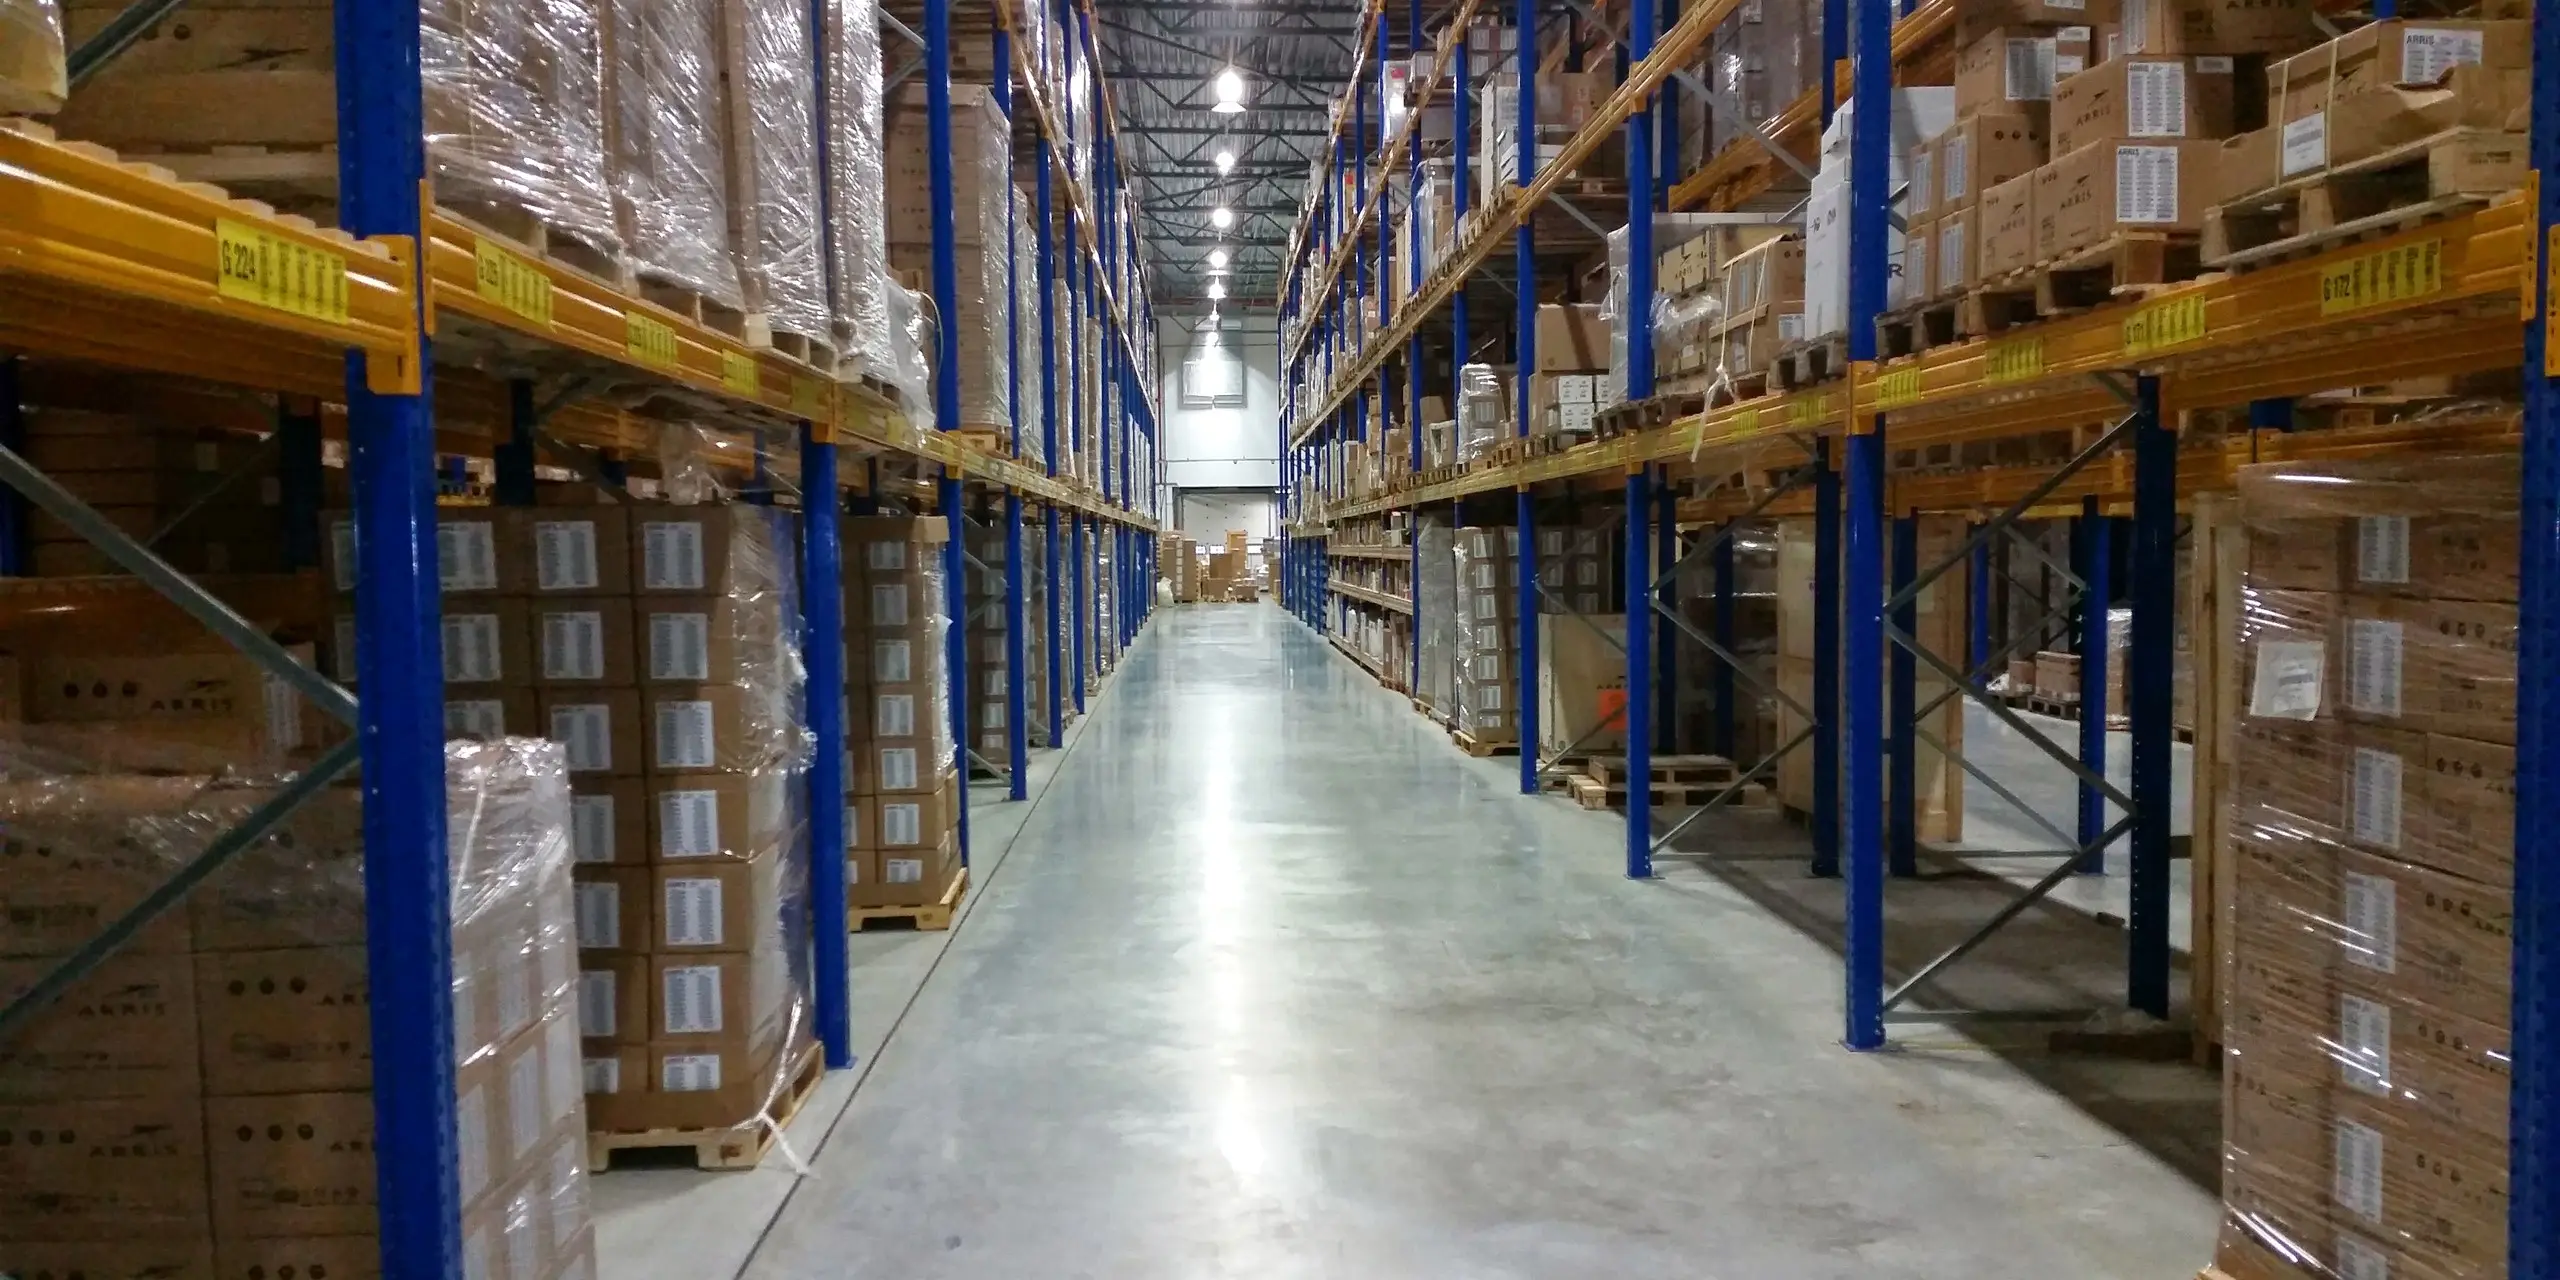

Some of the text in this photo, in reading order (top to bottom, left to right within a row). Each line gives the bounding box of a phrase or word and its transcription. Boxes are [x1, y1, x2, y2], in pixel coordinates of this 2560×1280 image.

[2406, 34, 2435, 45] ARRIS
[2076, 104, 2111, 127] ARRIS
[2060, 190, 2092, 210] ARRIS
[222, 239, 231, 275] G
[234, 242, 256, 281] 224
[2323, 273, 2350, 302] G 172
[78, 1002, 166, 1018] ARRIS
